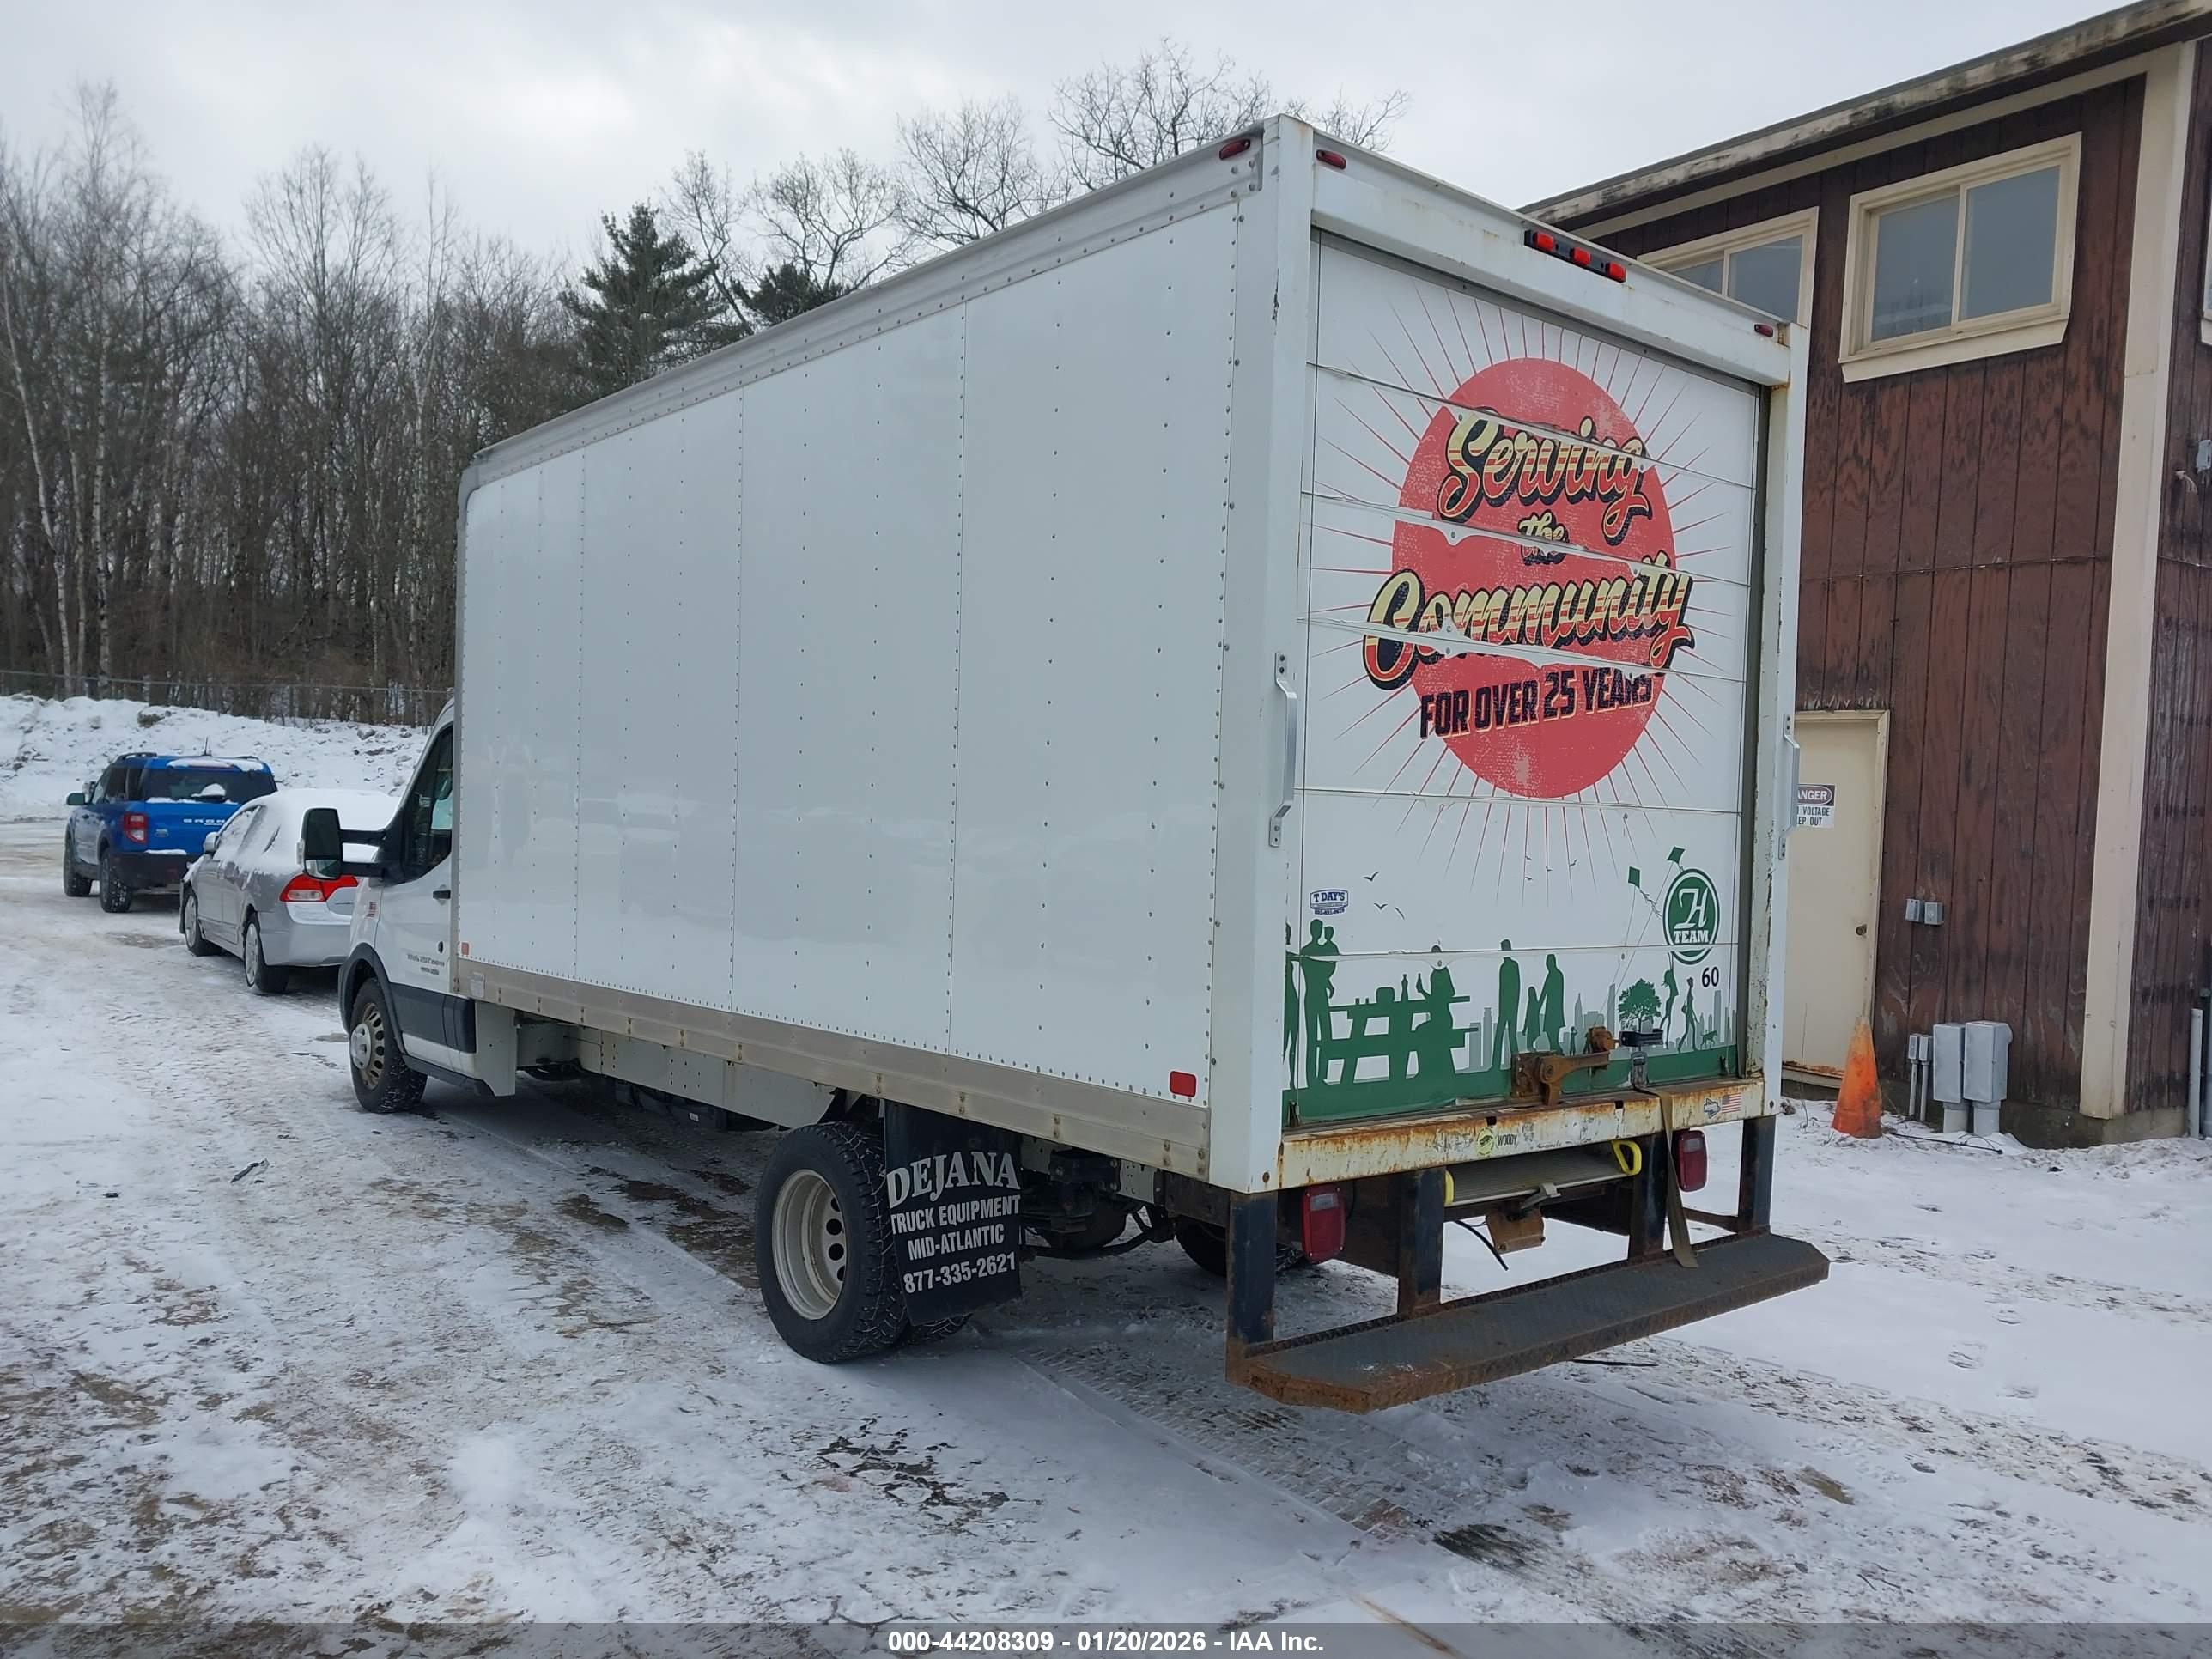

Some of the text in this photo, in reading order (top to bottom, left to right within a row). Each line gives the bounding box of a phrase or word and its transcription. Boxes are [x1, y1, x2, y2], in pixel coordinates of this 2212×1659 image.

[1437, 406, 1651, 545] Serving
[1518, 510, 1569, 565] the
[1363, 550, 1694, 690] Community
[1419, 690, 1472, 738] FOR
[1474, 678, 1539, 732] OVER
[1543, 669, 1576, 720] 25
[1803, 806, 1830, 816] VOLTAGE
[1809, 817, 1823, 826] OUT
[1313, 891, 1346, 902] T DAY'S
[1673, 930, 1709, 944] TEAM
[1701, 966, 1720, 988] 60
[886, 1151, 1021, 1210] DEJANA
[890, 1194, 1021, 1236] TRUCK EQUIPMENT
[908, 1224, 1004, 1261] MID-ATLANTIC
[903, 1251, 1015, 1294] 877-335-2621
